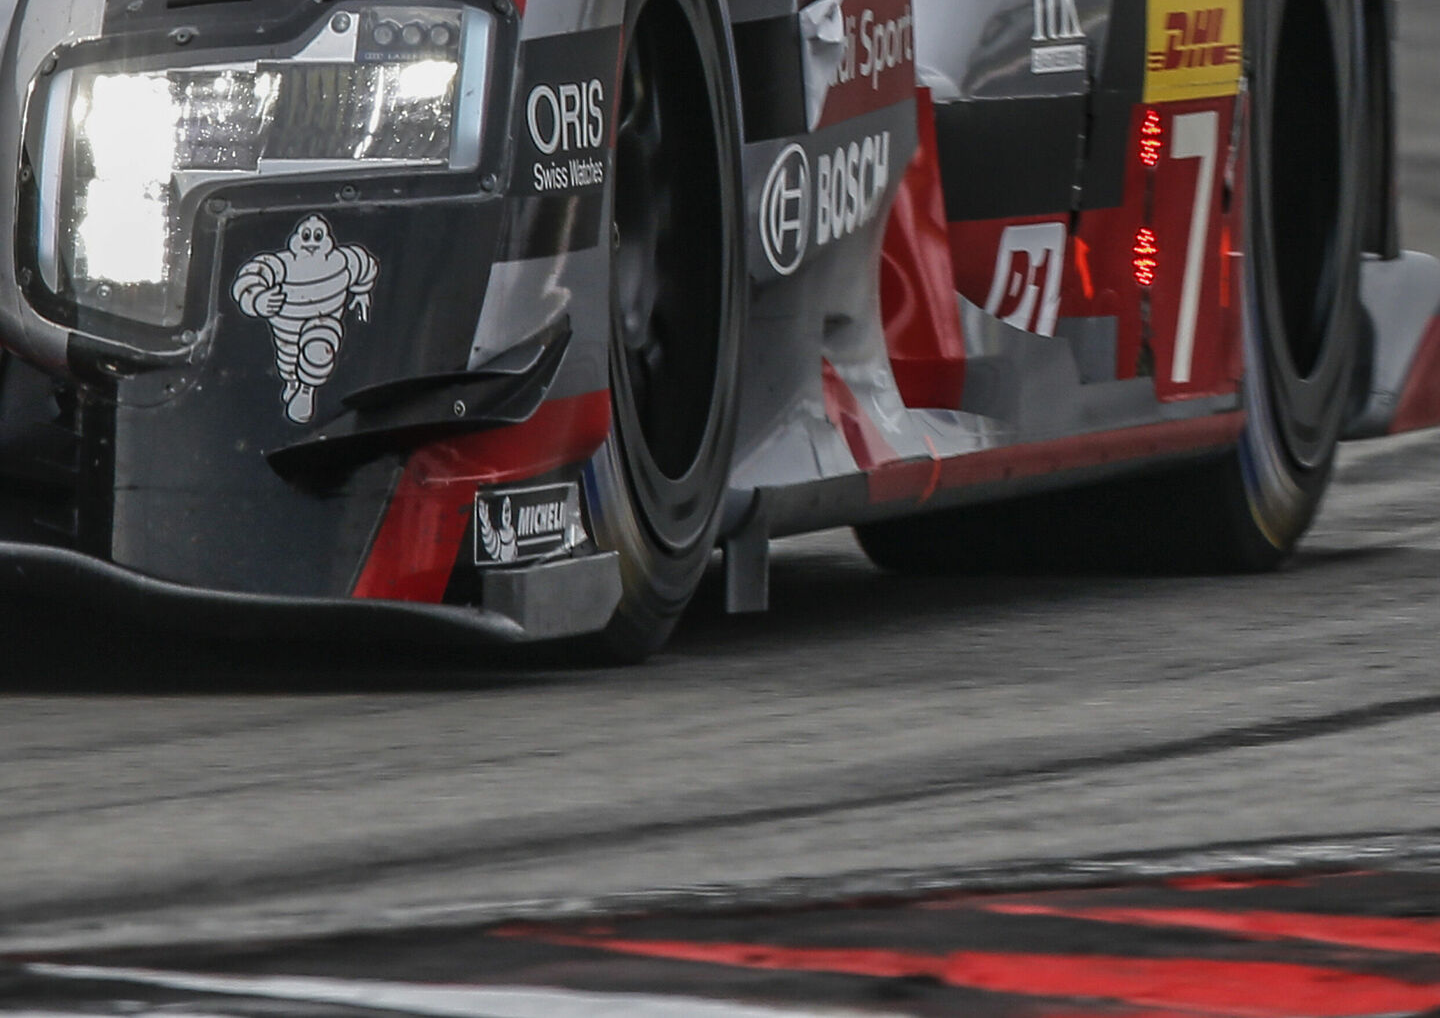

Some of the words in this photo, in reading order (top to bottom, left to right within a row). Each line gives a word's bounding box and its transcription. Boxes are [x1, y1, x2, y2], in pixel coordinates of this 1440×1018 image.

[858, 4, 913, 91] Sport
[1162, 7, 1232, 72] DHL
[526, 78, 604, 155] ORIS
[533, 161, 569, 192] Swiss
[568, 156, 604, 188] Watches
[816, 131, 891, 247] BOSCH
[1169, 110, 1220, 383] 7
